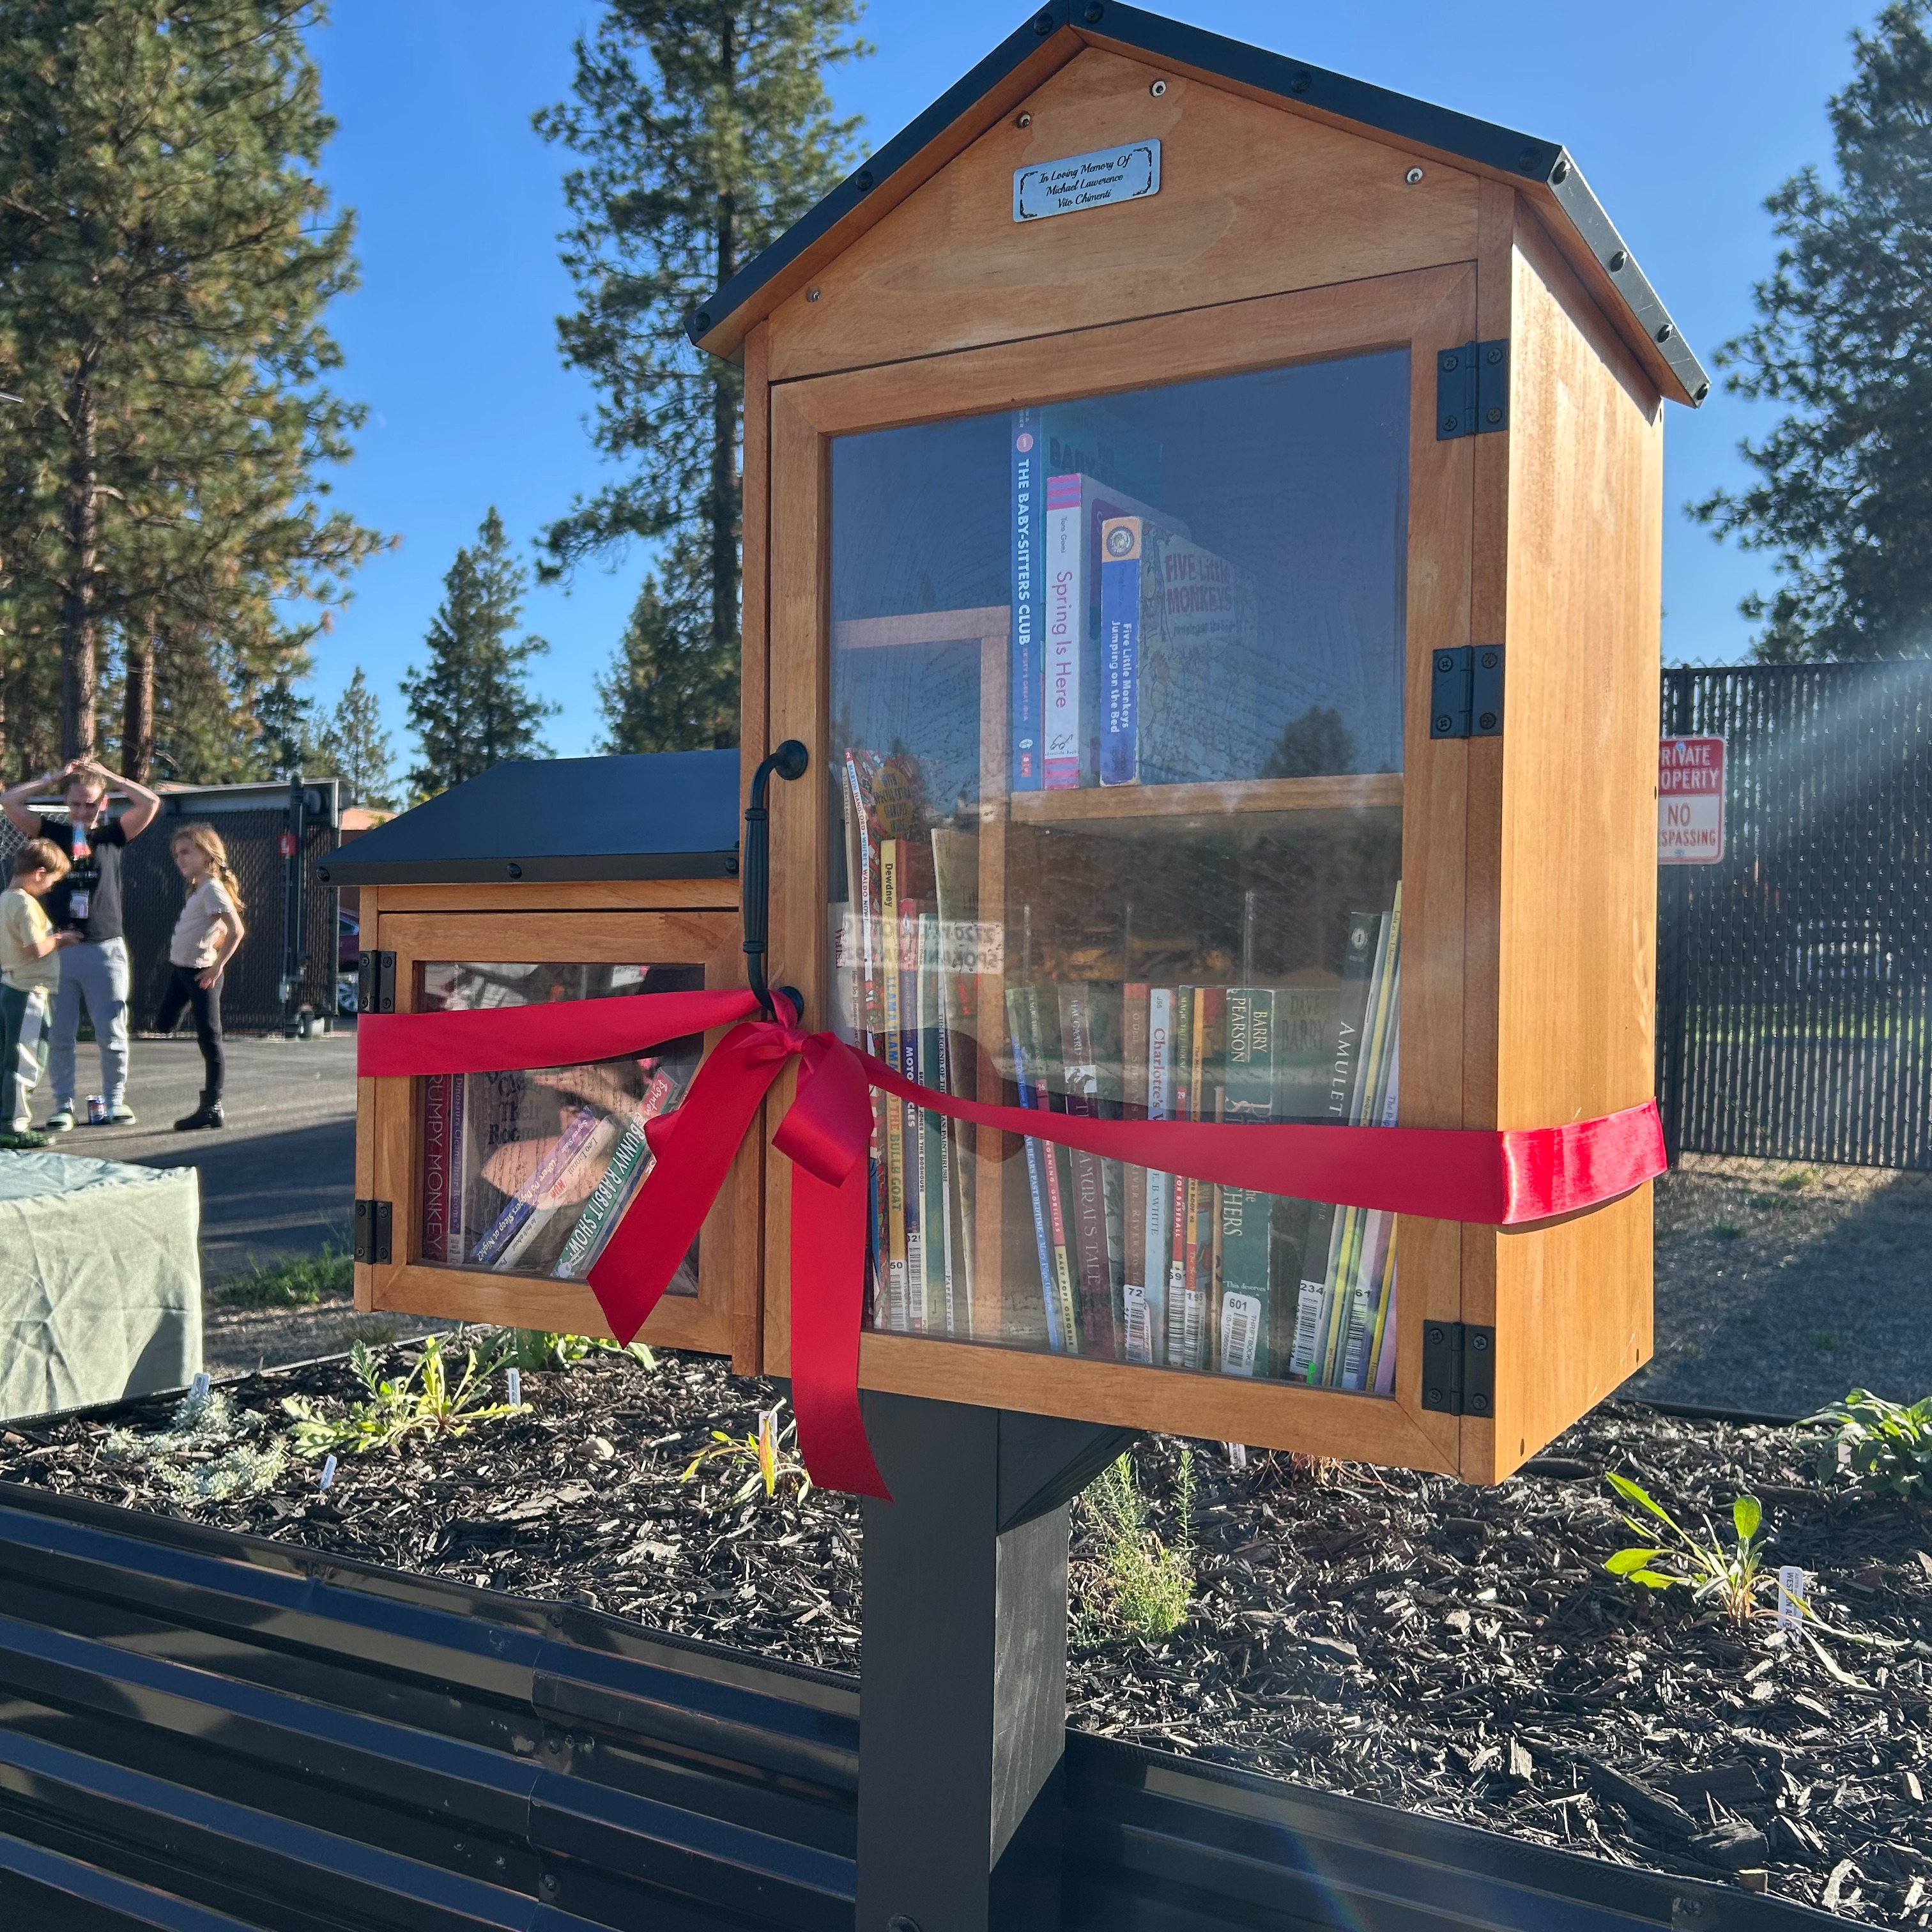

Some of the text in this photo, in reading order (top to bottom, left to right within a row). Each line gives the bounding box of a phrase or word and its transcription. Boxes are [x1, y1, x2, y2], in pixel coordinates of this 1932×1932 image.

[1039, 153, 1132, 184] In Loving Memory Of
[1046, 180, 1080, 196] Michael
[1058, 189, 1112, 208] Vito Chimenti
[1018, 459, 1031, 645] THE BABY-SITTERS CLUB
[1165, 553, 1197, 583] FIVE
[1167, 586, 1232, 615] MONKEYS
[1052, 571, 1073, 709] Spring Is Here
[1109, 620, 1120, 733] Jumping on the Bed
[1120, 623, 1133, 728] Five Little Monkeys
[1661, 744, 1712, 767] RIVATE
[848, 764, 857, 793] MARTIN
[1661, 767, 1720, 790] OPERTY
[1667, 802, 1690, 827] NO
[1659, 828, 1716, 847] SPASSING
[884, 863, 893, 908] Dewdney
[1357, 933, 1362, 942] 1
[1230, 997, 1246, 1063] PEARSON
[1252, 1011, 1268, 1054] BARRY
[1282, 1018, 1326, 1051] BARRY
[1152, 1027, 1166, 1108] Charlotte's
[1329, 1021, 1356, 1117] AMULET
[453, 1077, 464, 1126] Dinosaurs
[644, 1079, 668, 1117] Boynton
[1177, 1091, 1186, 1100] 29
[890, 1107, 900, 1131] THE
[453, 1128, 463, 1157] Clean
[585, 1136, 599, 1153] Leo
[612, 1122, 646, 1176] BUNNY
[889, 1133, 901, 1174] BULLY
[426, 1073, 444, 1251] RUMPY MONKEY
[452, 1159, 462, 1183] Their
[1027, 1149, 1036, 1174] BEARS
[588, 1166, 623, 1221] RABBIT
[891, 1177, 902, 1212] GOAT
[1030, 1175, 1038, 1195] PAST
[477, 1159, 556, 1262] Where Do Diggers Sleep at Night?
[1051, 1189, 1061, 1233] GORILLAS
[1078, 1149, 1101, 1285] AMURAI'S TALE
[1151, 1197, 1160, 1237] WHITE
[1229, 1298, 1247, 1312] 601
[1300, 1283, 1324, 1296] 234
[1064, 1305, 1074, 1346] OSBORNE
